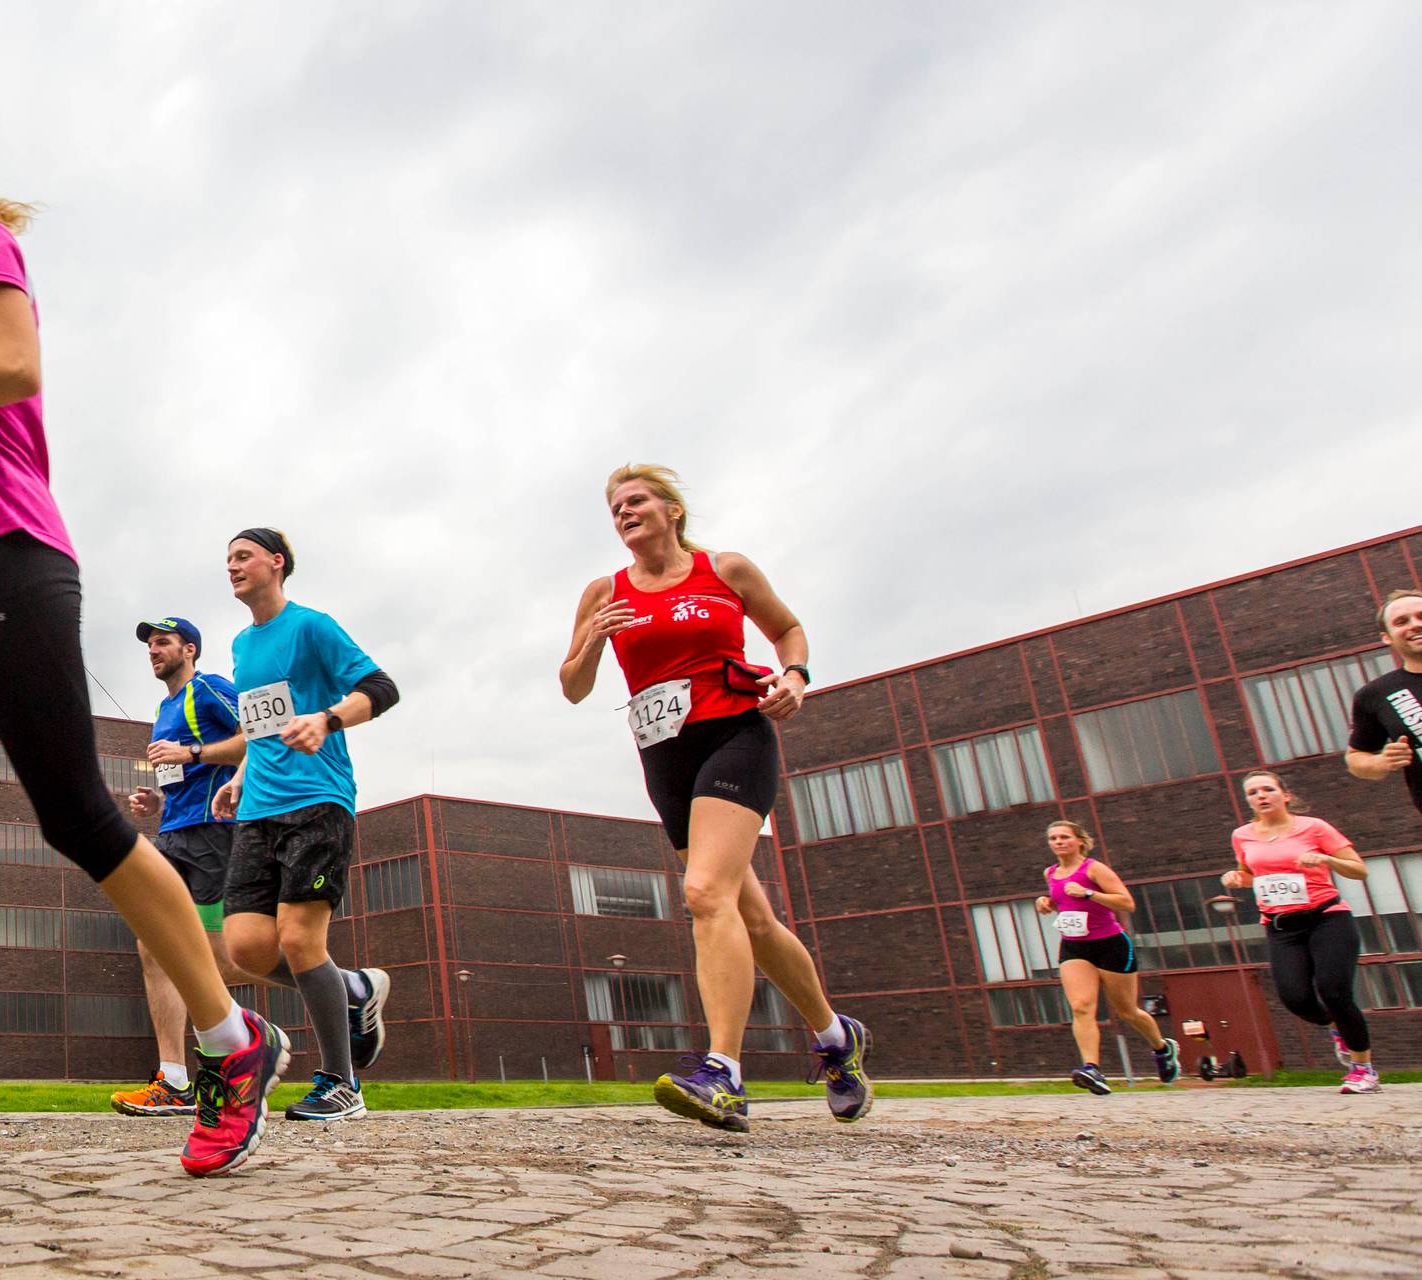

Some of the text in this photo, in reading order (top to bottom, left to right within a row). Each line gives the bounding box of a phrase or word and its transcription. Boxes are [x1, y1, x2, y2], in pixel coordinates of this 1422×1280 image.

[243, 697, 286, 724] 1130
[635, 695, 683, 730] 1124
[1260, 881, 1300, 897] 1490
[1058, 918, 1083, 929] 1545
